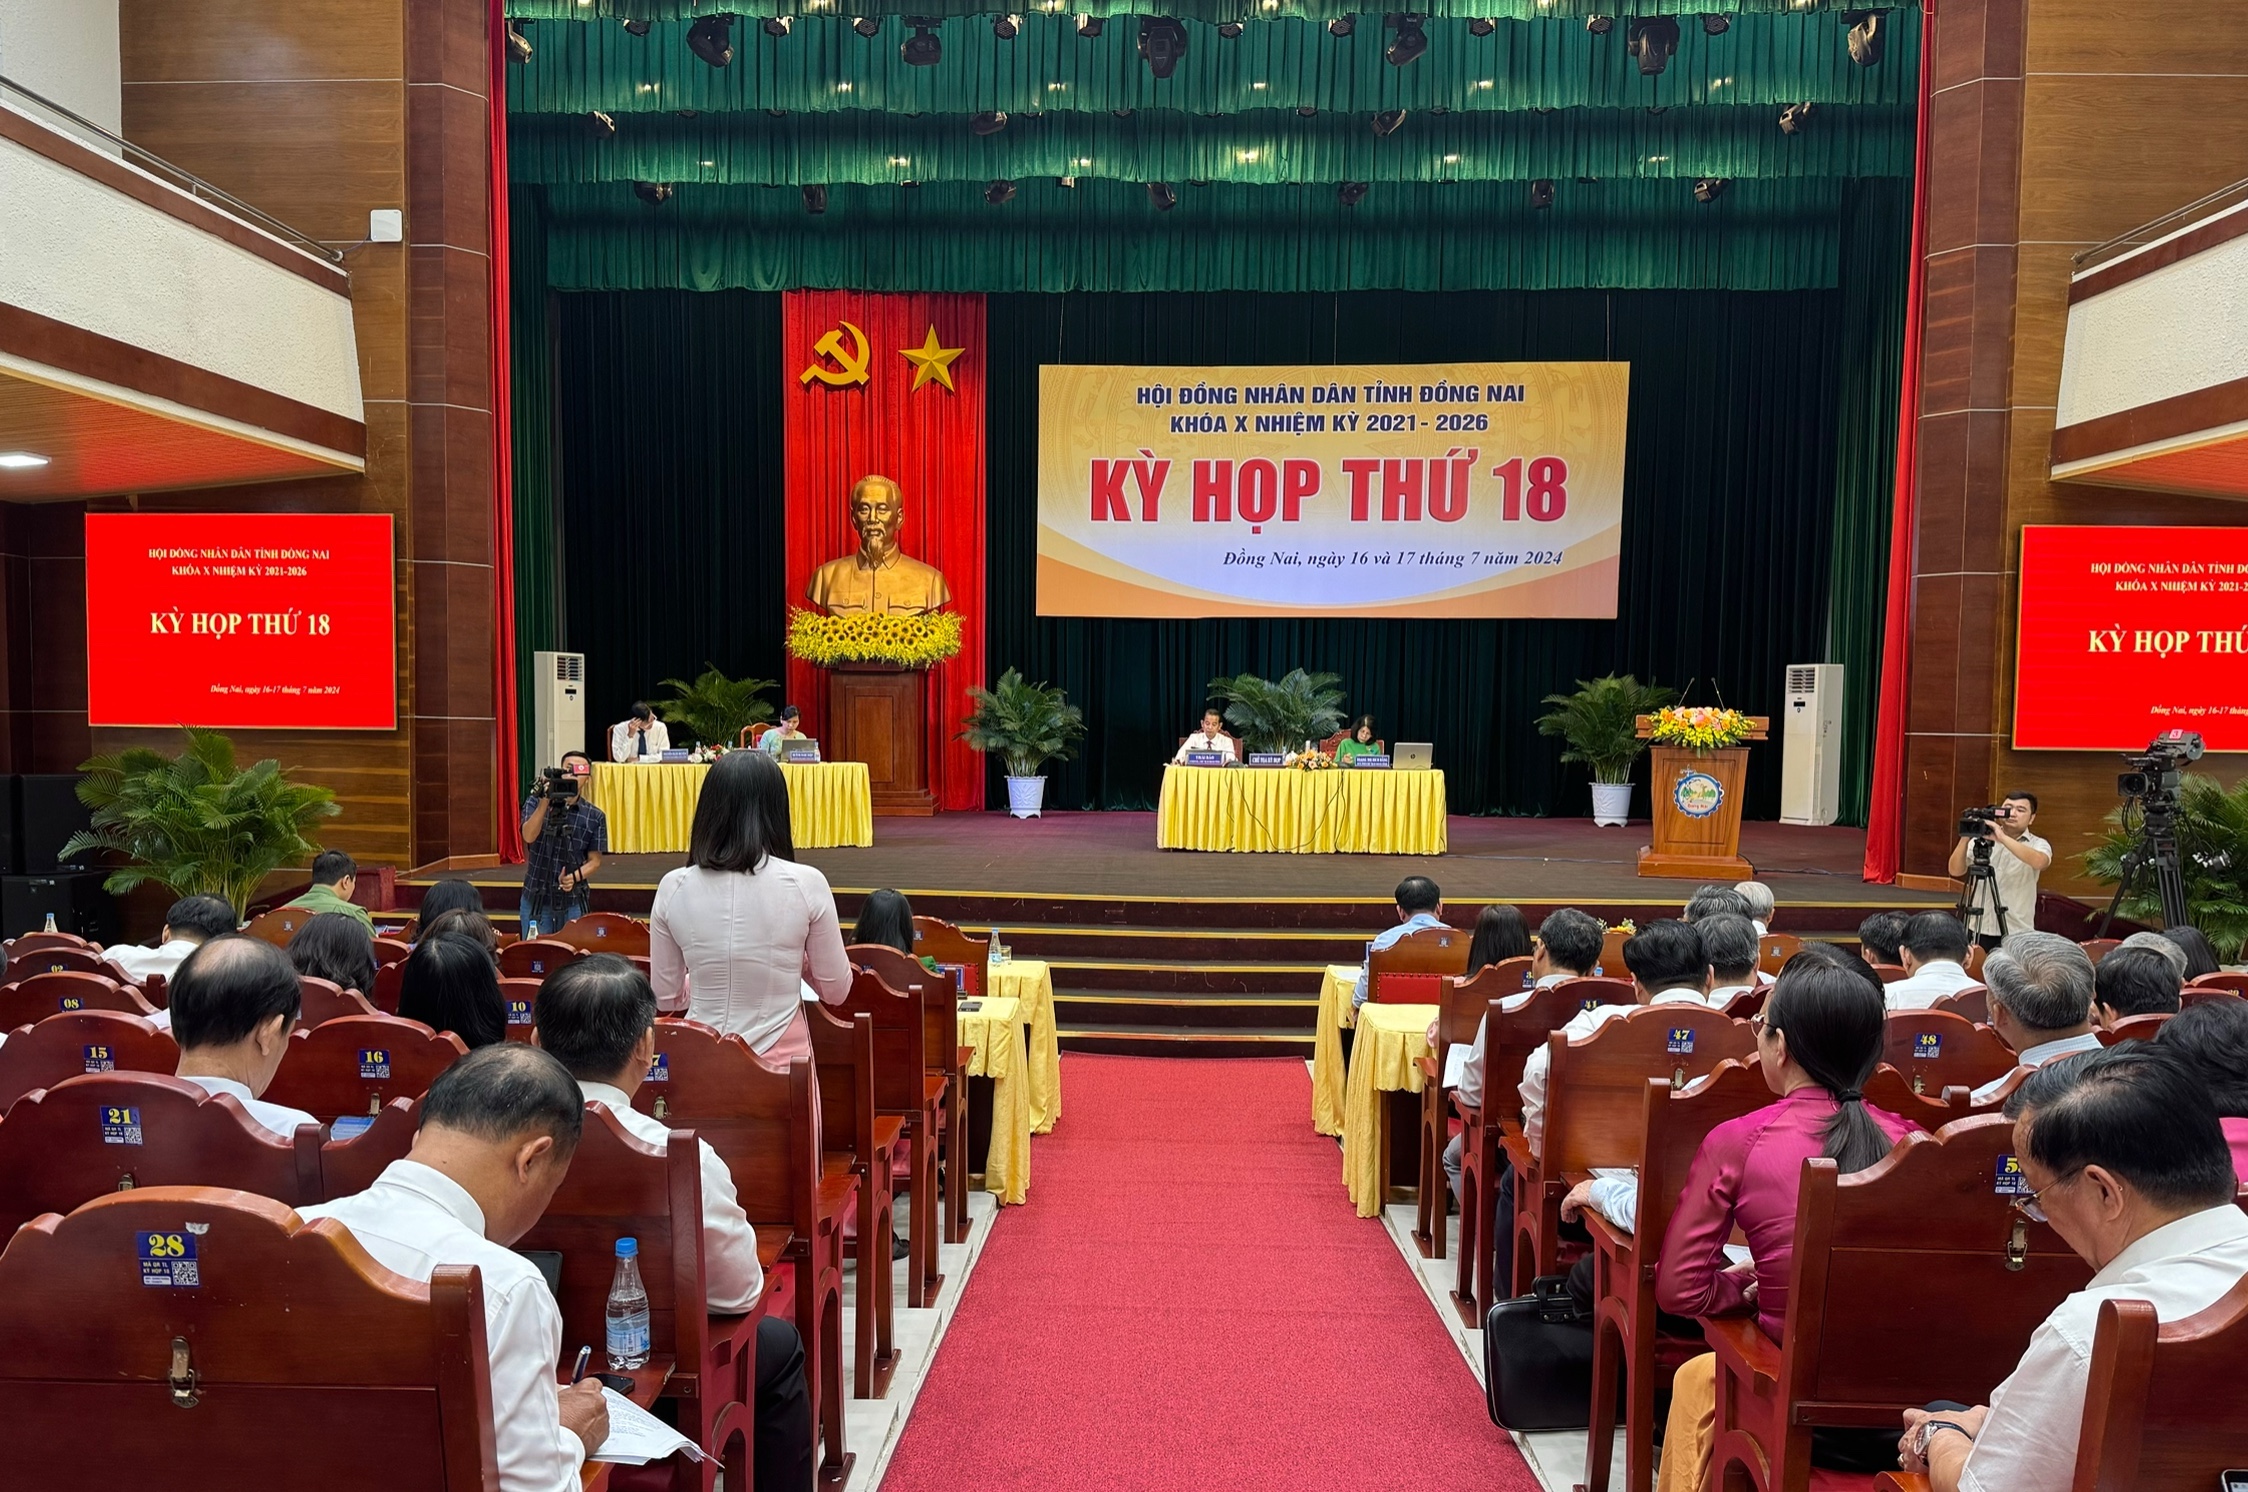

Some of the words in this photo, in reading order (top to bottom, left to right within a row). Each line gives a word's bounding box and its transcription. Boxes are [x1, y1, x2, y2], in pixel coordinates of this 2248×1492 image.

[1137, 384, 1171, 408] HỘI
[1179, 382, 1237, 404] ĐỒNG
[1245, 383, 1304, 404] NHÂN
[1312, 382, 1356, 403] DÂN
[1363, 380, 1412, 403] TỈNH
[1420, 380, 1479, 403] ĐỒNG
[1487, 385, 1524, 402] NAI
[1170, 412, 1227, 433] KHÓA
[1234, 416, 1248, 432] X
[1256, 412, 1325, 435] NHIỆM
[1332, 411, 1359, 432] KỲ
[1366, 414, 1416, 431] 2021
[1436, 414, 1488, 431] 2026
[1090, 449, 1172, 521] KỲ
[1192, 459, 1321, 535] HỌP
[1342, 448, 1479, 522] THỨ
[1492, 457, 1567, 522] 18
[148, 548, 167, 560] HỘI
[200, 546, 229, 559] NHÂN
[231, 546, 251, 559] DÂN
[312, 549, 330, 559] NAI
[1223, 548, 1266, 568] Đồng
[1269, 552, 1302, 567] Nai,
[1307, 551, 1346, 568] ngày
[1350, 551, 1369, 565] 16
[1374, 551, 1390, 565] và
[1396, 551, 1416, 565] 17
[1419, 551, 1465, 568] tháng
[1471, 551, 1480, 565] 7
[1484, 552, 1519, 565] năm
[1524, 551, 1563, 565] 2024
[172, 563, 201, 576] KHÓA
[204, 566, 210, 576] X
[213, 565, 246, 578] NHIỆM
[248, 564, 262, 576] KỲ
[265, 566, 307, 576] 2021-2026
[2148, 561, 2179, 574] NHÂN
[2182, 561, 2204, 574] DÂN
[2115, 578, 2148, 591] KHÓA
[2150, 581, 2158, 591] X
[2160, 580, 2197, 594] NHIỆM
[150, 606, 185, 634] KỲ
[191, 613, 242, 640] HỌP
[247, 607, 302, 635] THỨ
[308, 613, 331, 636] 18
[2088, 623, 2127, 653] KỲ
[2133, 630, 2190, 659] HỌP
[262, 685, 281, 694] 16-17
[282, 685, 301, 695] tháng
[324, 686, 340, 695] 2024
[64, 998, 79, 1009] 08
[511, 1001, 526, 1012] 10
[1673, 1029, 1690, 1040] 47
[1920, 1034, 1937, 1045] 48
[90, 1047, 108, 1059] 15
[365, 1051, 384, 1064] 16
[652, 1054, 661, 1067] 7
[108, 1108, 133, 1124] 21
[2005, 1157, 2021, 1174] 5
[148, 1234, 185, 1257] 28
